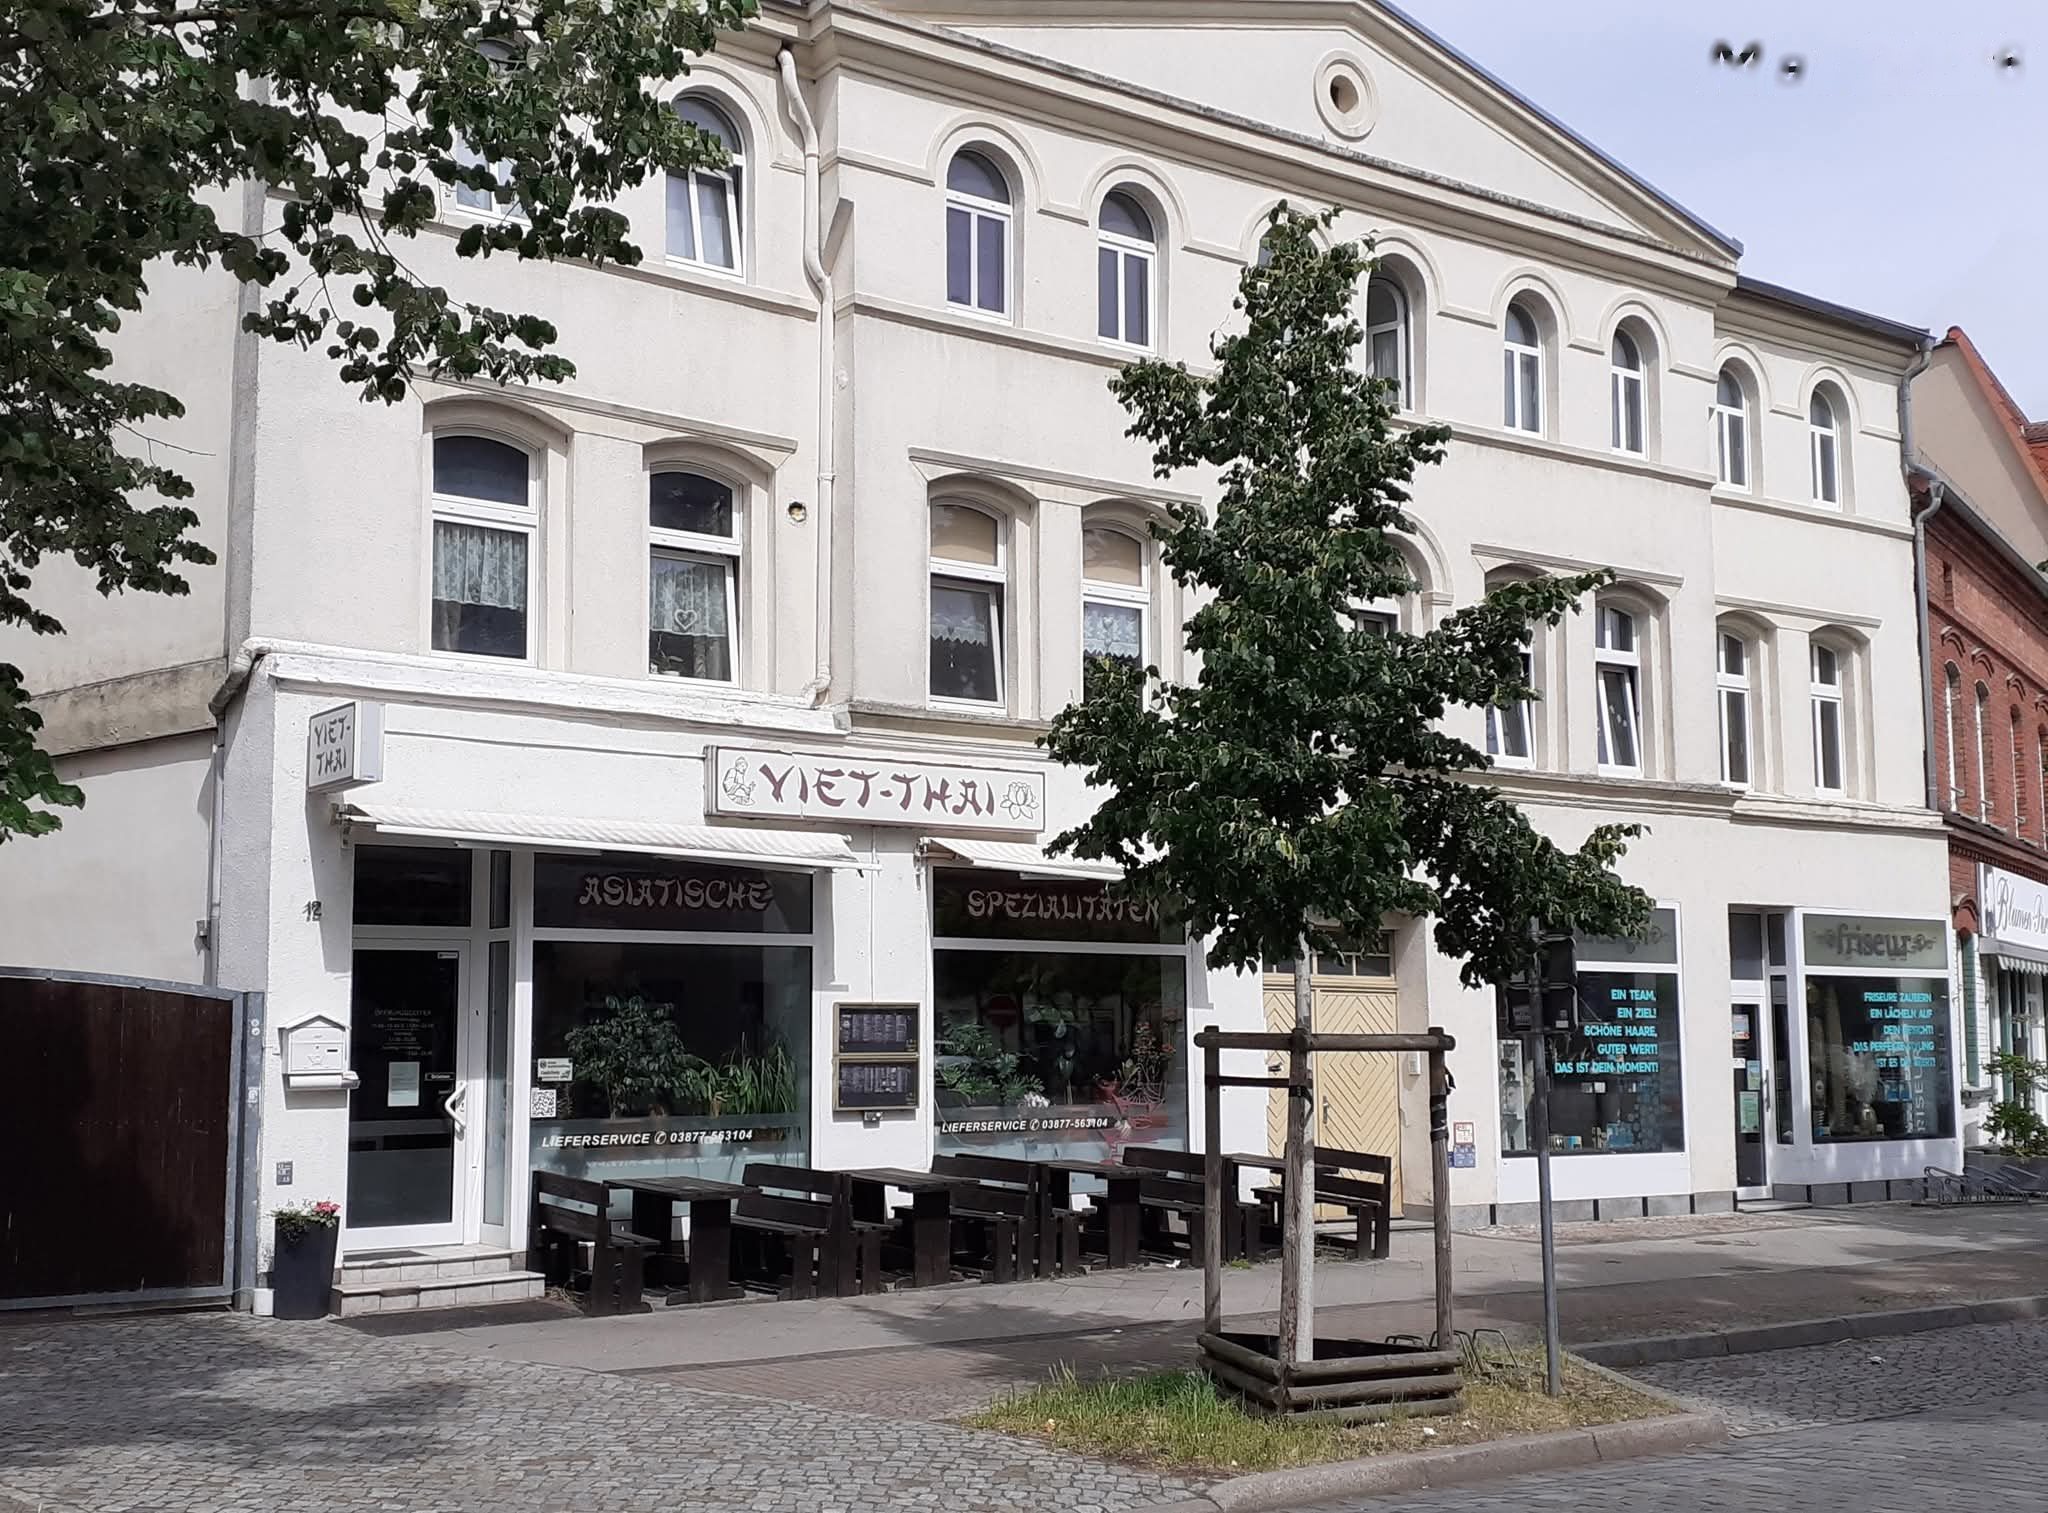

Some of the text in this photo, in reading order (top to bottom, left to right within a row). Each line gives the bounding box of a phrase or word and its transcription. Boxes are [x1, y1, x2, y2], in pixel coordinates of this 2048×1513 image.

[315, 715, 351, 747] VIET-
[316, 747, 347, 776] THAI
[758, 763, 995, 817] VIET-THAI
[579, 876, 774, 910] ASIATISCHE
[302, 901, 322, 917] 12
[968, 888, 1160, 922] SPEZIALITÄTEN
[1611, 989, 1656, 1001] EIN TEAM,
[1617, 1007, 1656, 1018] EIN ZIEL!
[1870, 1006, 1933, 1018] EIN LÄCHELN AUF
[1584, 1023, 1658, 1037] SCHÖNE HAARE,
[1597, 1044, 1658, 1054] GUTER WERT!
[1853, 1042, 1868, 1052] DAS
[1554, 1062, 1658, 1073] DAS IST DEIN MOMENT!
[1888, 1058, 1898, 1068] ES
[941, 1118, 1108, 1133] LIEFERSERVICE 03877-563104
[541, 1133, 650, 1148] LIEFERSERVICE
